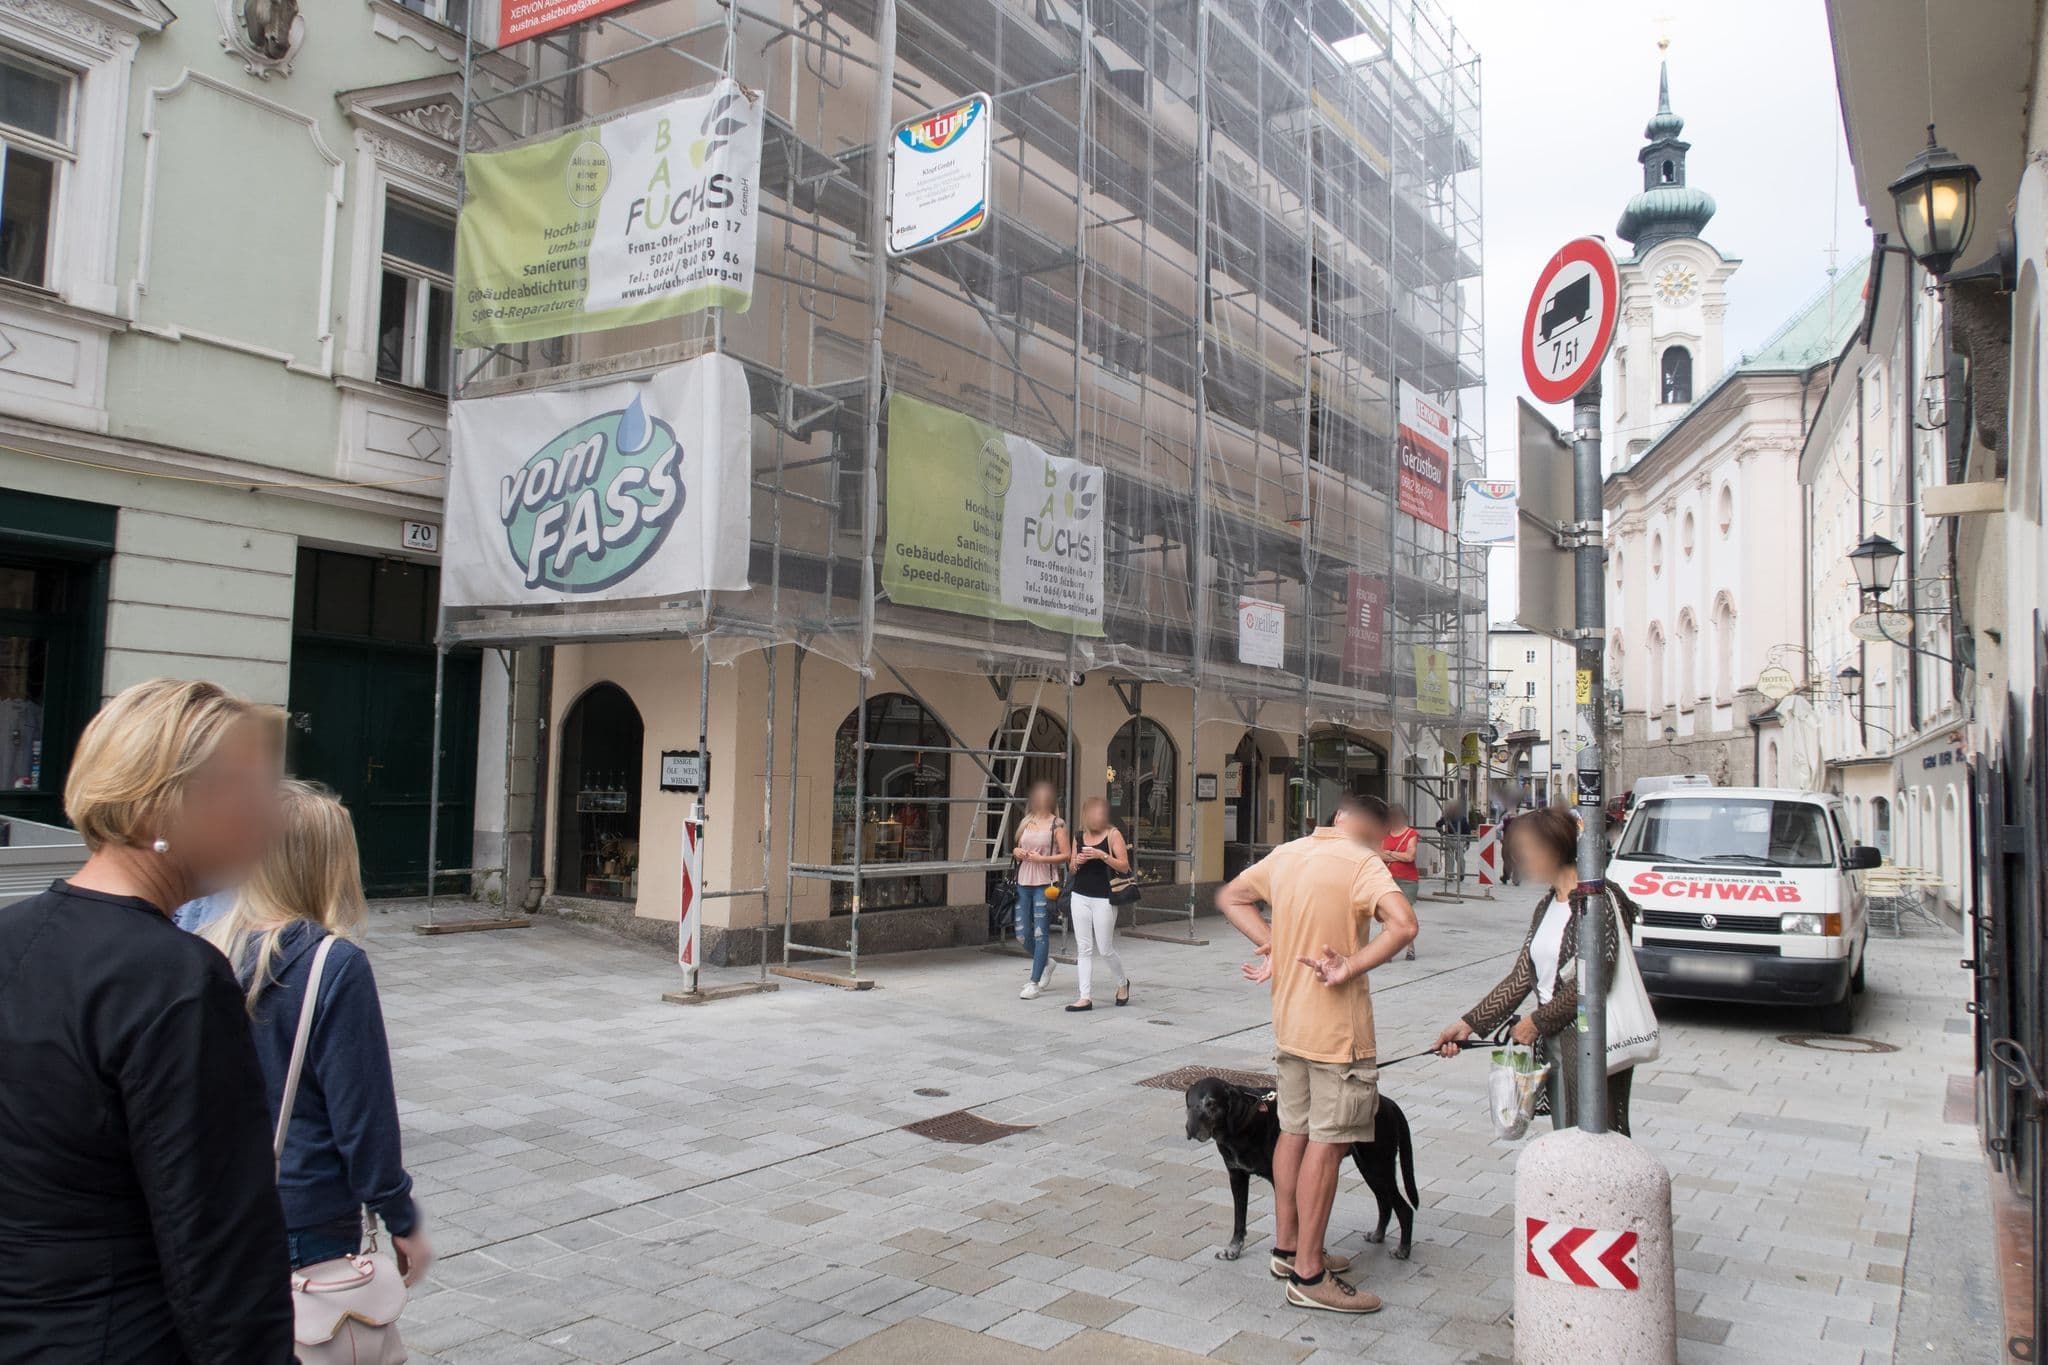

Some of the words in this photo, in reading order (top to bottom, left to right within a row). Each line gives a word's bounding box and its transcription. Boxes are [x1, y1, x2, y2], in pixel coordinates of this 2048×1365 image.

[511, 1, 546, 20] XERVON
[911, 108, 974, 146] KLOPF
[625, 173, 734, 236] FUCHS
[544, 219, 595, 240] Hochbau
[726, 220, 742, 233] 17
[548, 239, 591, 255] Umbau
[723, 251, 740, 264] 46
[523, 256, 587, 276] Sanierung
[649, 251, 673, 266] 5020
[1552, 338, 1578, 374] 7,5t
[1402, 445, 1442, 484] Gerüstbau
[501, 432, 607, 528] vom
[525, 441, 686, 589] FASS
[965, 499, 1002, 521] Hochbau
[412, 524, 431, 541] 70
[973, 520, 1000, 540] Umbau
[1024, 517, 1092, 562] FUCHS
[957, 536, 999, 561] Sanierung
[1040, 572, 1058, 583] 5020
[1761, 675, 1790, 683] HOTEL
[1628, 872, 1802, 903] SCHWAB
